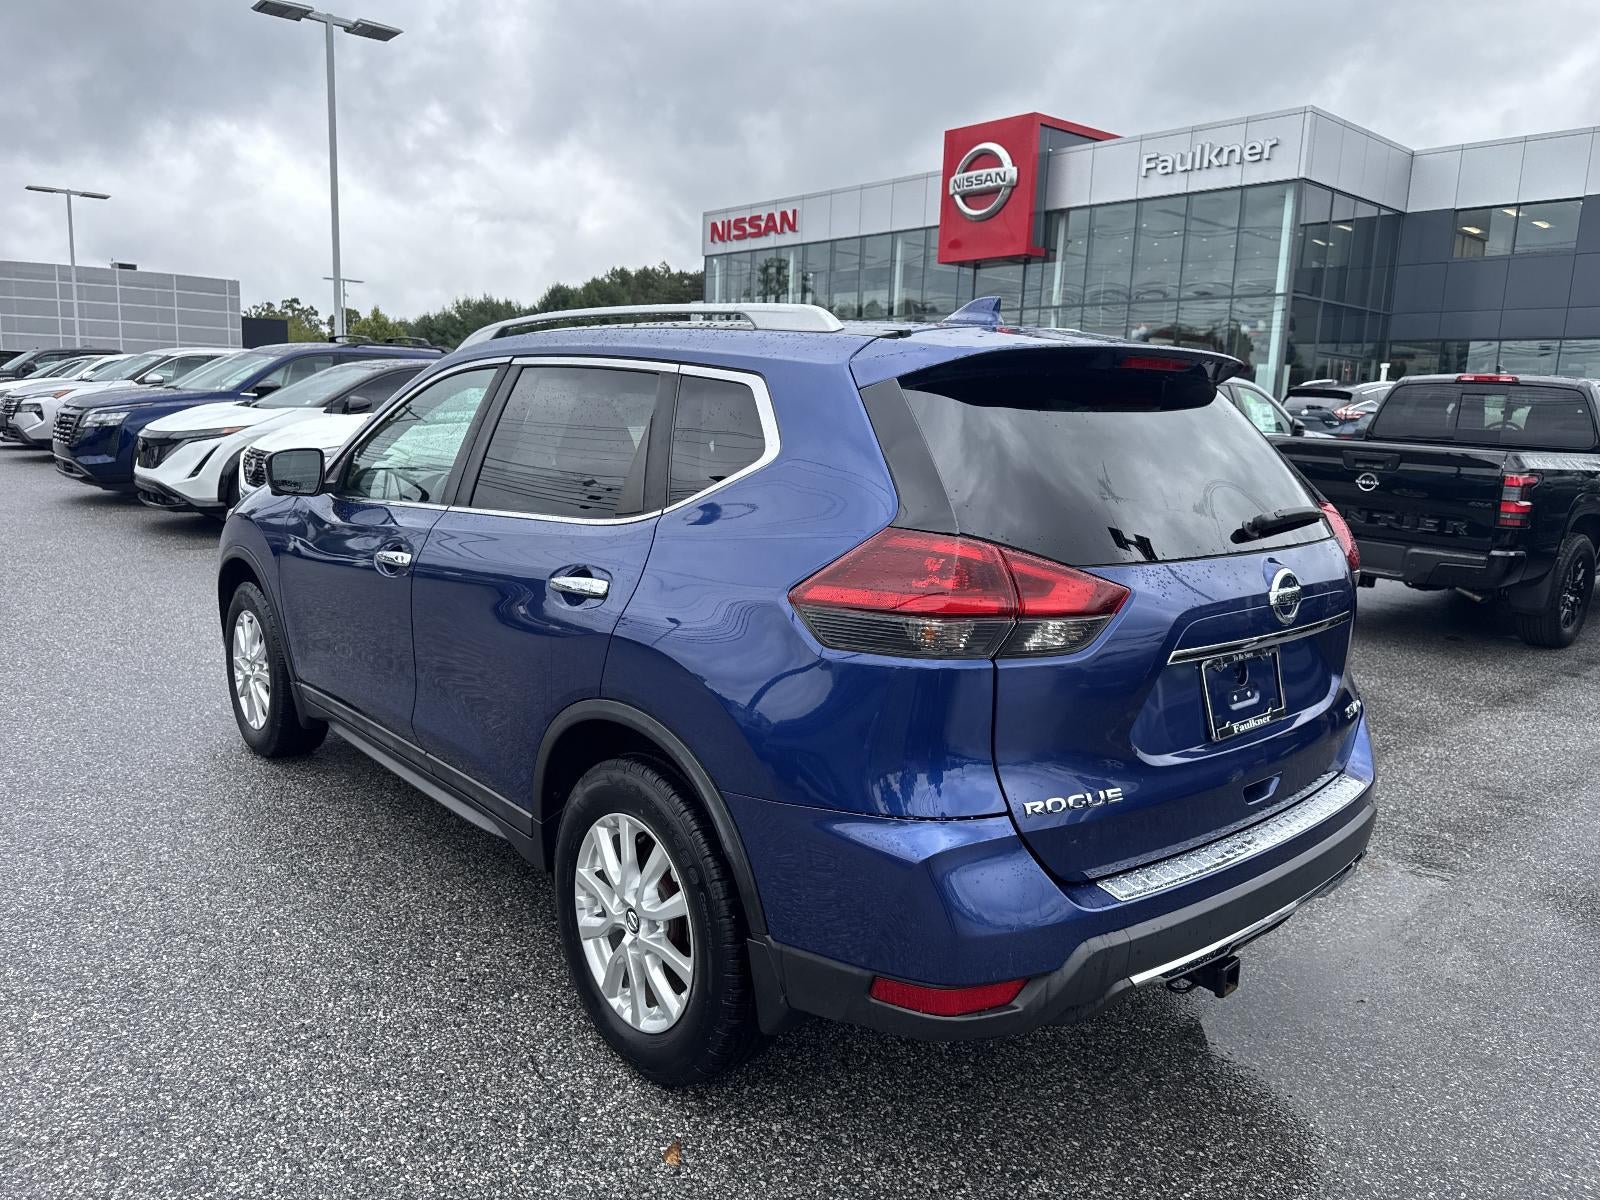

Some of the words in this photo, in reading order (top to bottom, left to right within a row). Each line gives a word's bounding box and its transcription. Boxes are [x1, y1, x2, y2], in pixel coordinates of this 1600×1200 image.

[1141, 136, 1279, 177] Faulkner
[953, 171, 1007, 190] NISSAN
[710, 208, 798, 243] NISSAN
[1345, 509, 1469, 536] NTIER
[1232, 715, 1272, 734] Faulkner
[1023, 787, 1124, 818] ROGUE
